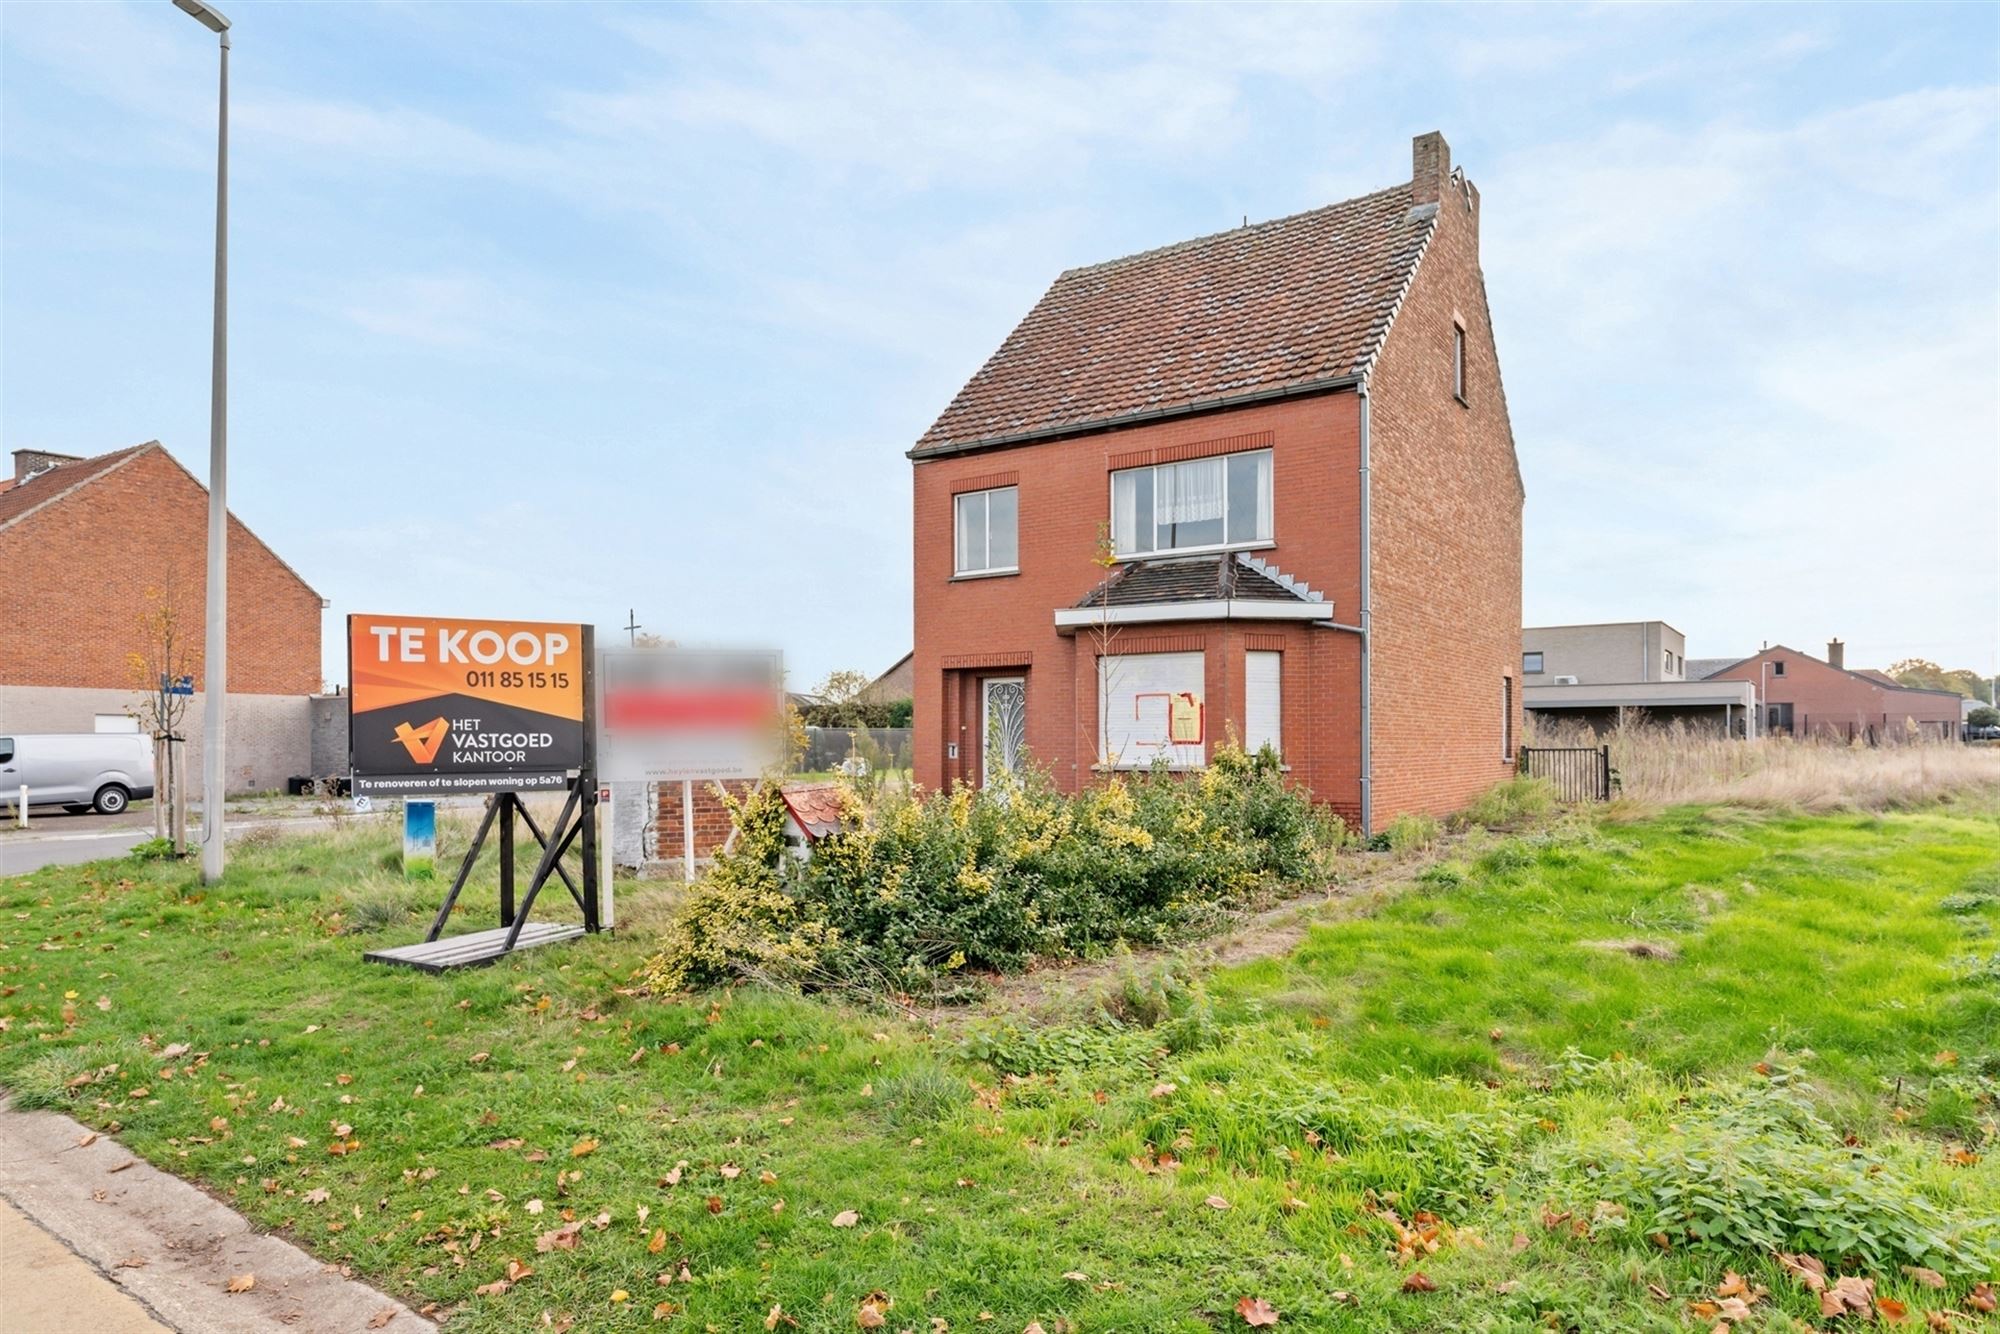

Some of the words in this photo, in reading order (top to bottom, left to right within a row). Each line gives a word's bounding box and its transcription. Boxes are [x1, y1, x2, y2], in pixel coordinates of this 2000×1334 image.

[370, 626, 425, 662] TE
[439, 629, 569, 666] KOOP
[466, 670, 494, 687] 011
[500, 671, 523, 688] 85
[528, 672, 546, 688] 15
[550, 672, 569, 688] 15
[452, 719, 480, 731] HET
[452, 733, 553, 748] VASTGOED
[453, 751, 526, 763] KANTOOR
[359, 779, 372, 789] Te
[374, 780, 427, 789] renoveren
[429, 778, 440, 787] of
[441, 779, 452, 787] te
[454, 778, 487, 788] slopen
[489, 776, 524, 787] woning
[525, 777, 538, 786] op
[539, 775, 563, 784] 5a76
